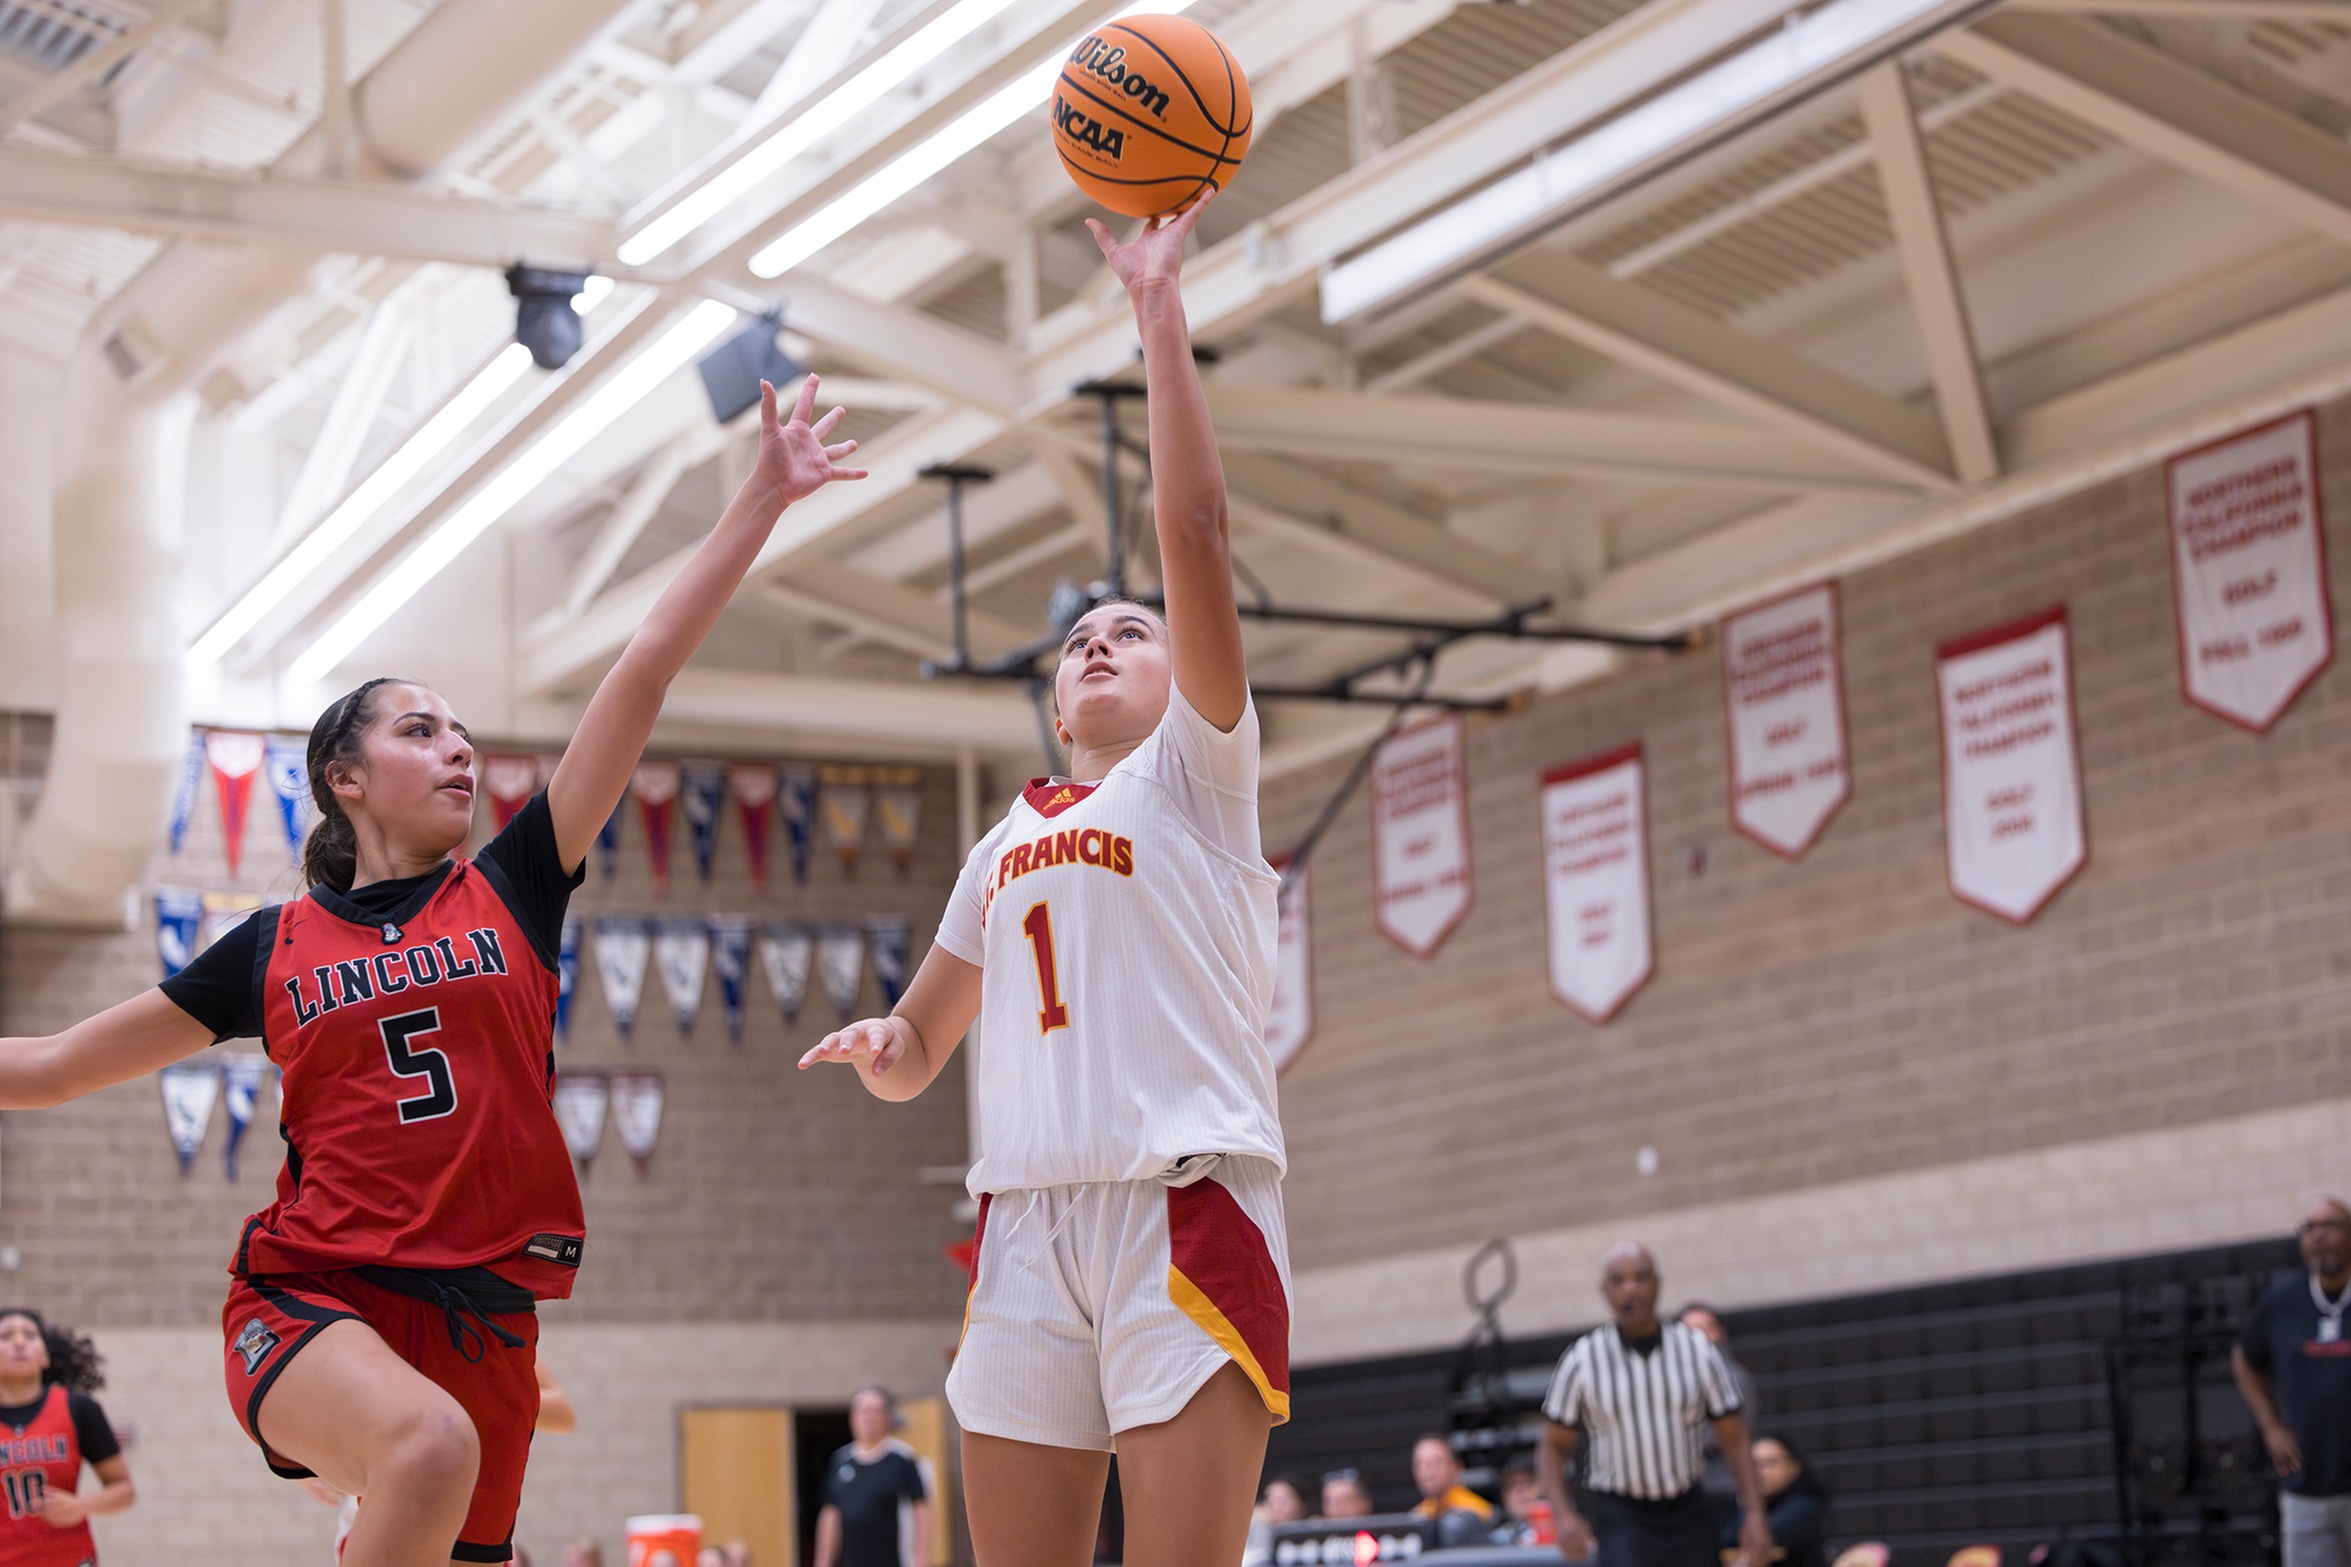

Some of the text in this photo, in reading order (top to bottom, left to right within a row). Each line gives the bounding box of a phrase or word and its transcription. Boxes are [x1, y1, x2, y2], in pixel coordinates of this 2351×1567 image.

[1069, 34, 1170, 118] Wilson
[1052, 93, 1125, 161] NCAA
[997, 828, 1135, 893] FRANCIS
[284, 927, 508, 1030] LINCOLN
[1022, 900, 1070, 1037] 1
[377, 1005, 459, 1126] 5
[564, 1245, 577, 1259] M
